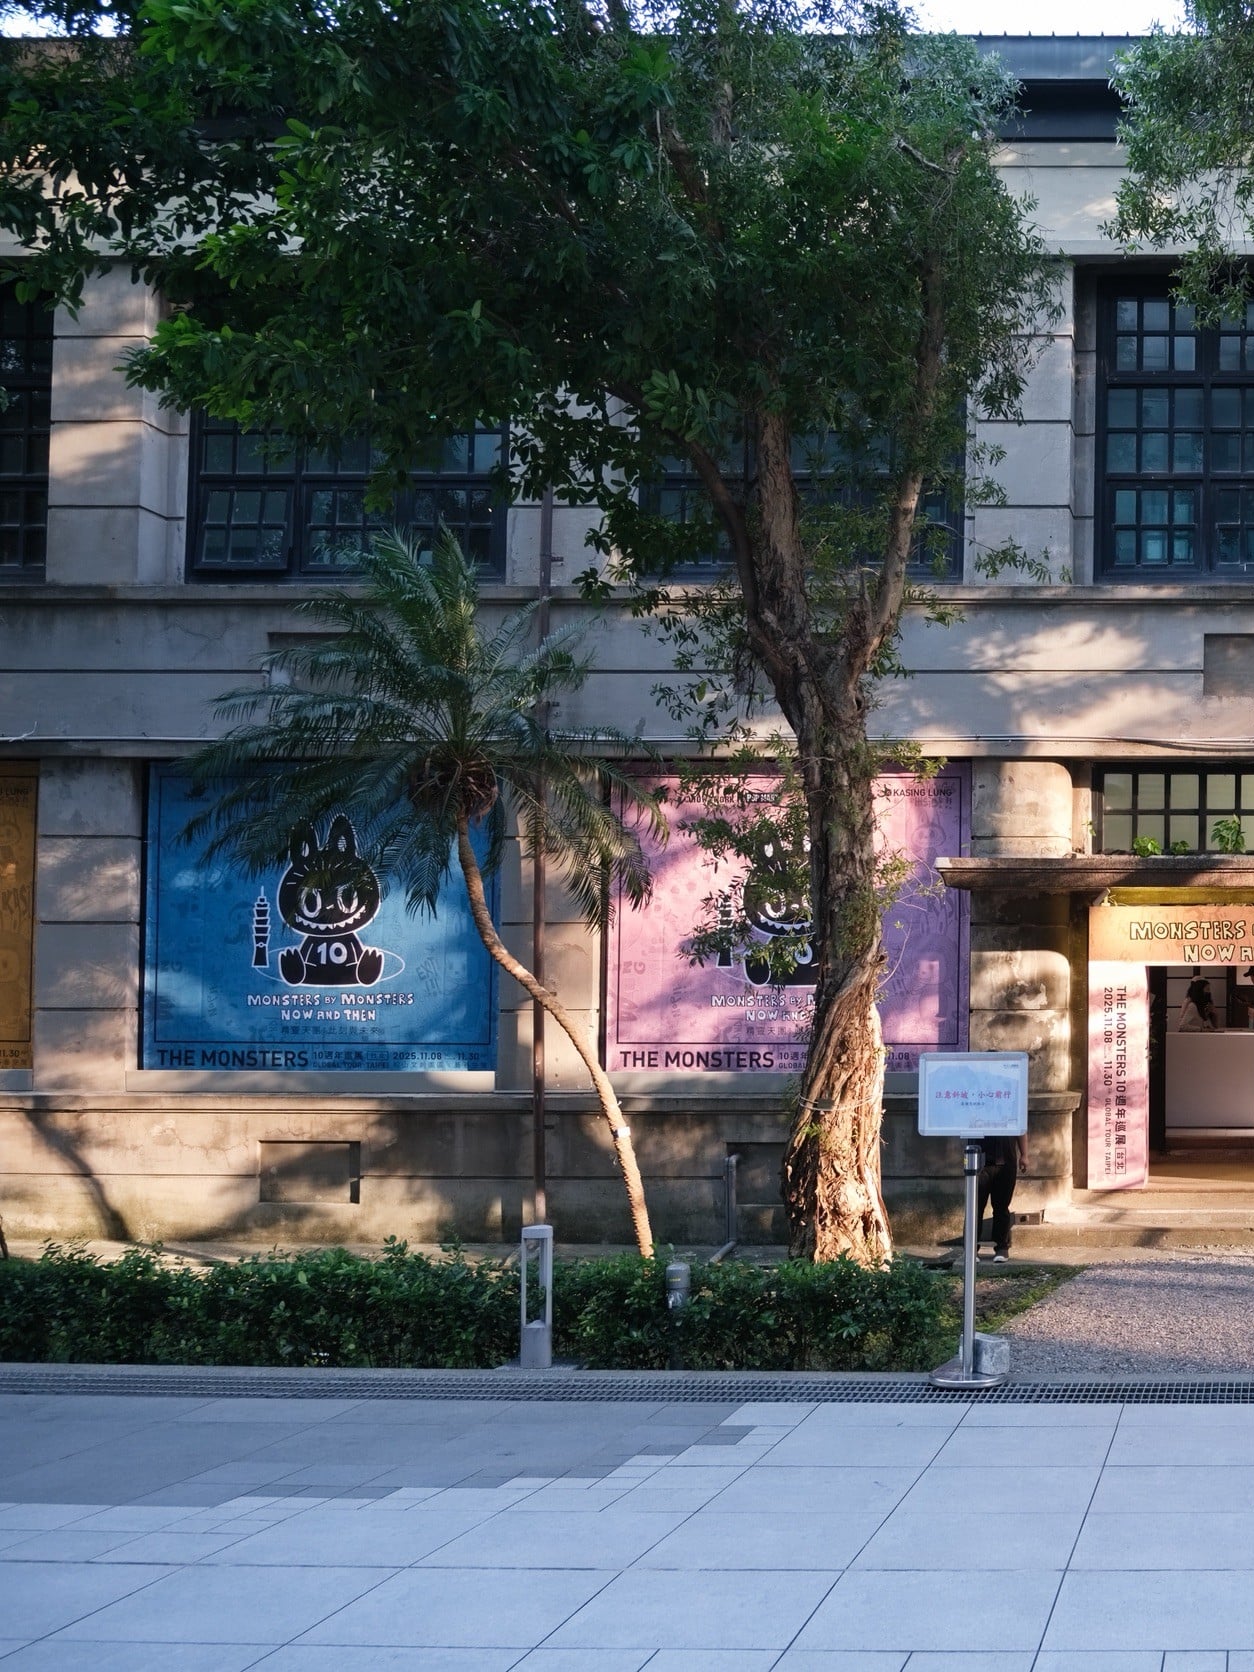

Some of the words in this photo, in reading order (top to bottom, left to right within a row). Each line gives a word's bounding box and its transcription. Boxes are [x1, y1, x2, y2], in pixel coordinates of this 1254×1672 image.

[893, 789, 926, 797] KASING
[928, 789, 952, 797] LUNG
[1129, 920, 1247, 940] MONSTERS
[316, 942, 348, 965] 10
[1183, 943, 1235, 963] NOW
[247, 994, 321, 1006] MONSTERS
[325, 996, 337, 1004] BY
[340, 993, 414, 1005] MONSTERS
[711, 995, 786, 1007] MONSTERS
[1116, 986, 1127, 1009] THE
[281, 1009, 315, 1021] NOW
[317, 1009, 341, 1021] AND
[344, 1009, 377, 1022] THEN
[746, 1010, 779, 1021] NOW
[1103, 986, 1113, 1043] 2025.11.08
[1116, 1012, 1127, 1077] MONSTERS
[157, 1049, 195, 1067] THE
[201, 1049, 309, 1067] MONSTERS
[393, 1052, 442, 1060] 2025.11.08
[457, 1052, 480, 1061] 11.30
[620, 1051, 658, 1067] THE
[665, 1051, 774, 1068] MONSTERS
[1103, 1060, 1113, 1086] 11.30
[1104, 1098, 1112, 1126] GLOBAL
[1104, 1129, 1112, 1148] TOUR
[1104, 1151, 1112, 1175] TAIPEI
